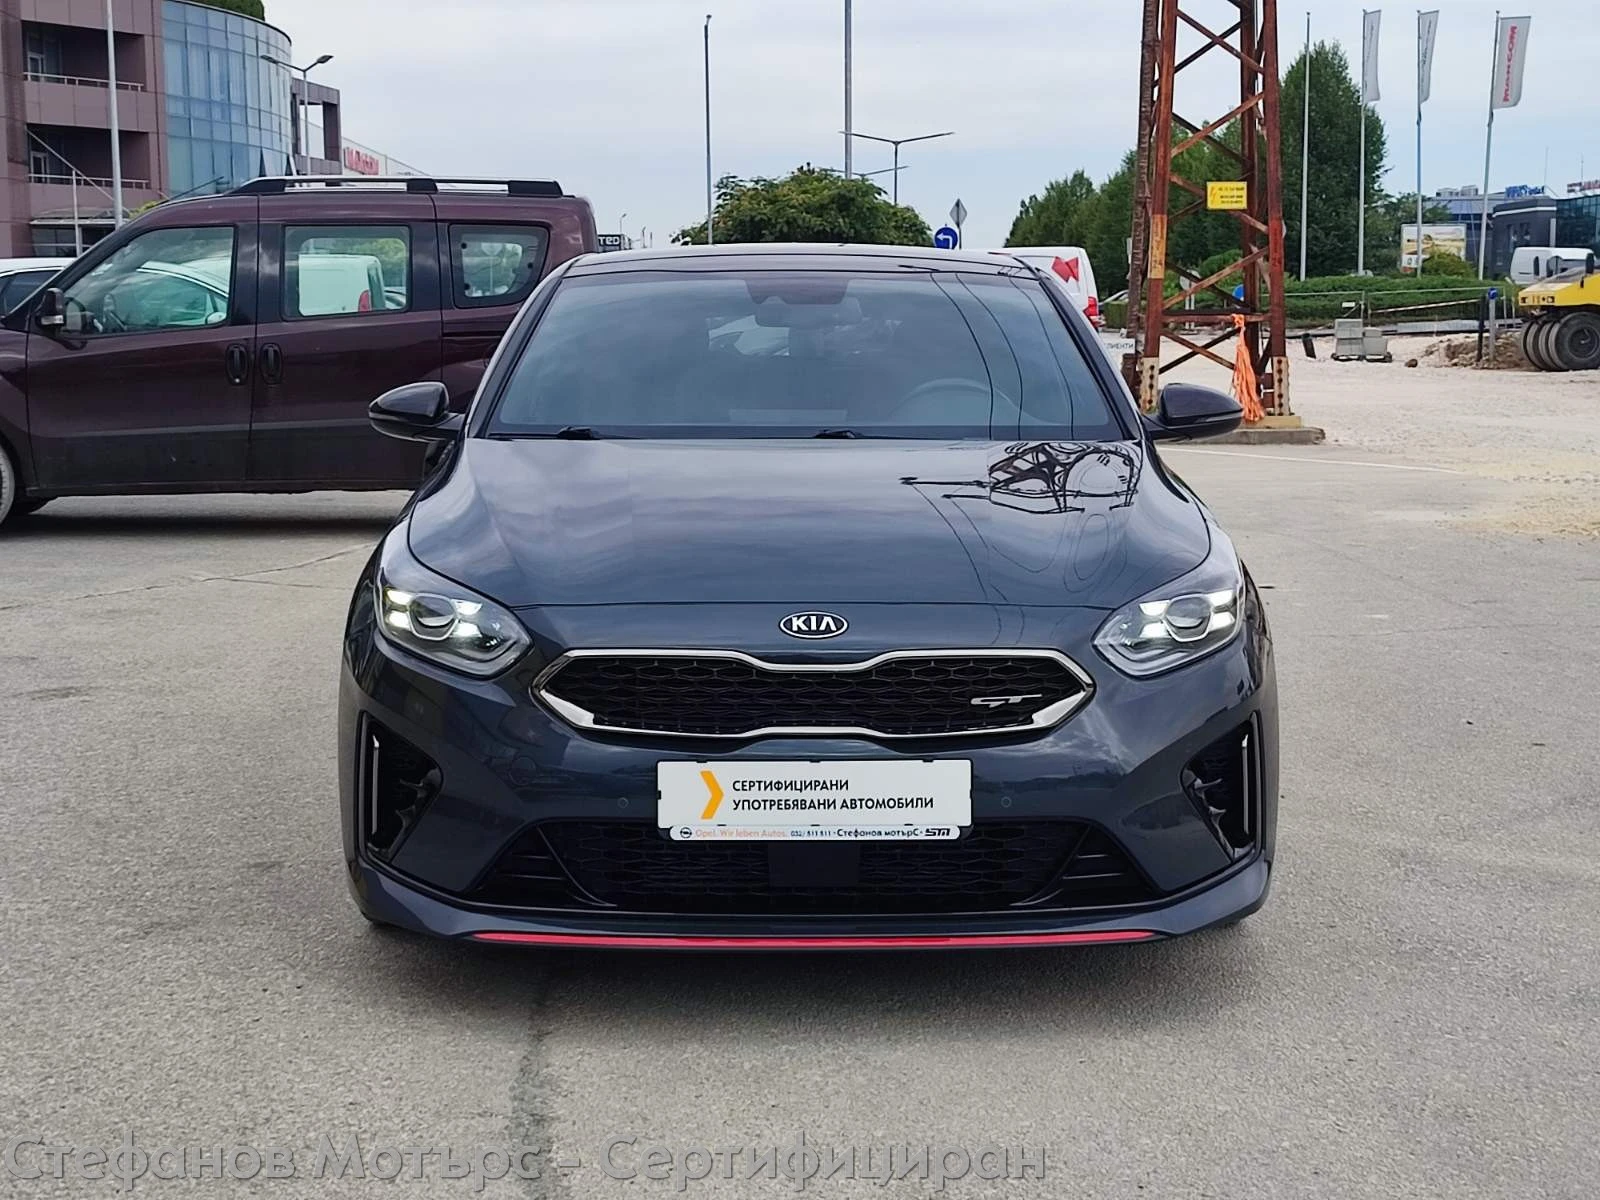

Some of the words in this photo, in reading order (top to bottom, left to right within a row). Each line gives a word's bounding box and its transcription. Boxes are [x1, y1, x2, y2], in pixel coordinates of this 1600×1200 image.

[791, 615, 838, 631] KIA
[970, 693, 1043, 708] GT
[732, 779, 849, 793] СЕРТИФИЦИРАНИ
[732, 798, 837, 811] УПОТРЕБЯВАНИ
[839, 797, 934, 810] АВТОМОБИЛИ
